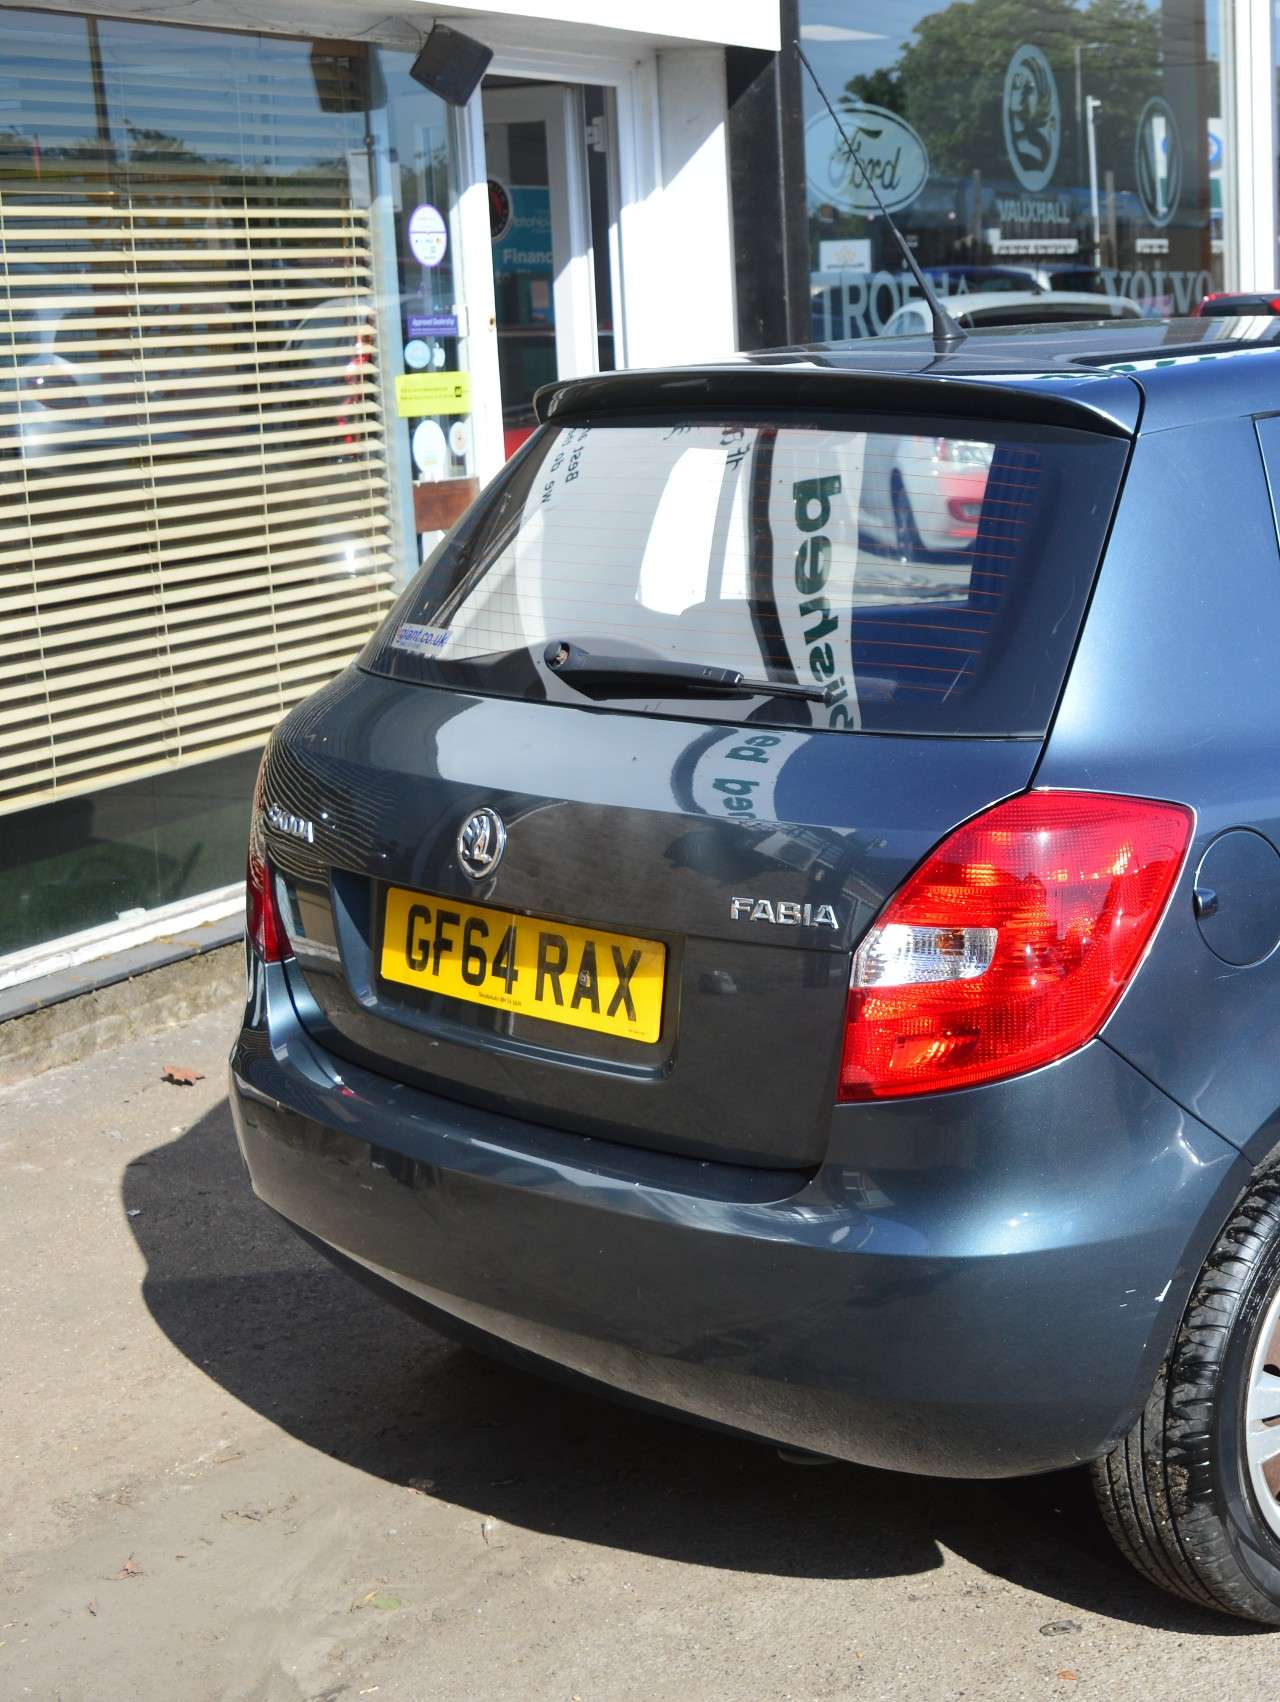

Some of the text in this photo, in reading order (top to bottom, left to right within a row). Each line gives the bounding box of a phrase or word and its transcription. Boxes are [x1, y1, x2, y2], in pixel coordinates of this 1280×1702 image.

[828, 123, 902, 190] Ford
[1000, 200, 1070, 223] VAUXHALL
[503, 248, 553, 265] Financ
[1101, 270, 1214, 317] VOLVO
[730, 896, 839, 929] FABIA
[406, 904, 641, 1022] GF64 RAX
